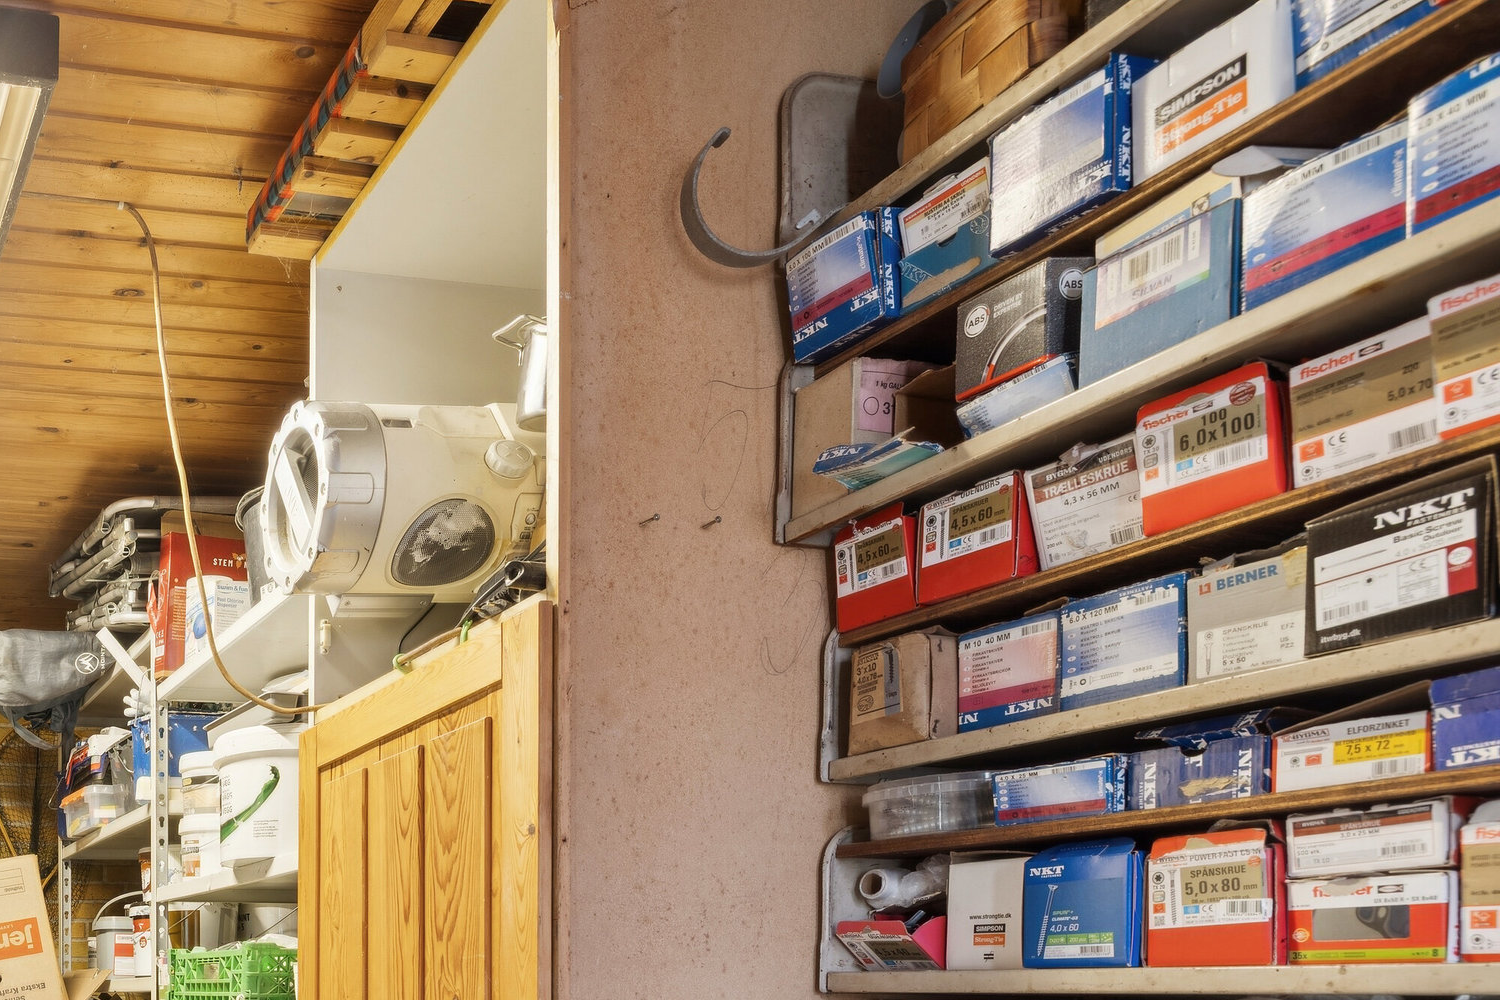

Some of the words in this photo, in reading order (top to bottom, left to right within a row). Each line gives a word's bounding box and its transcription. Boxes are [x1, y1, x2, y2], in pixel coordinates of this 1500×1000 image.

[1160, 62, 1241, 120] SIMPSON
[1162, 92, 1243, 144] Strong-Tie
[1121, 126, 1132, 182] NKT
[884, 264, 895, 310] NKT
[1064, 280, 1083, 290] ABS
[967, 312, 986, 329] ABS
[1299, 351, 1356, 380] fischer
[881, 381, 888, 390] kg
[1142, 409, 1189, 431] fischer
[1201, 408, 1227, 427] 100
[1180, 412, 1255, 452] 6,0x100
[1043, 460, 1130, 499] TRÆLLESKRUE
[1064, 496, 1077, 507] 4,3
[1087, 489, 1098, 499] 56
[1101, 481, 1120, 494] MM
[1373, 487, 1475, 531] NKT
[213, 558, 233, 568] STEM
[1216, 564, 1278, 591] BERNER
[1069, 615, 1080, 624] 6.0
[1090, 609, 1103, 618] 120
[1104, 604, 1119, 614] MM
[973, 639, 982, 648] 10
[985, 636, 995, 644] 40
[996, 632, 1011, 643] MM
[1005, 696, 1053, 717] NKT
[1347, 719, 1410, 735] ELFORZINKET
[1376, 740, 1390, 750] 72
[1029, 865, 1065, 877] NKT
[1190, 864, 1246, 879] SPÅNSKRUE
[1185, 880, 1208, 897] 5,0
[1221, 877, 1240, 892] 80
[969, 912, 1012, 921] www.strongtie.dk
[976, 925, 1004, 933] SIMPSON
[1050, 924, 1062, 933] 4,0
[1069, 923, 1079, 932] 60
[974, 934, 1004, 944] Strong-Tie
[1293, 951, 1308, 961] 35x
[21, 982, 46, 992] Ekstra
